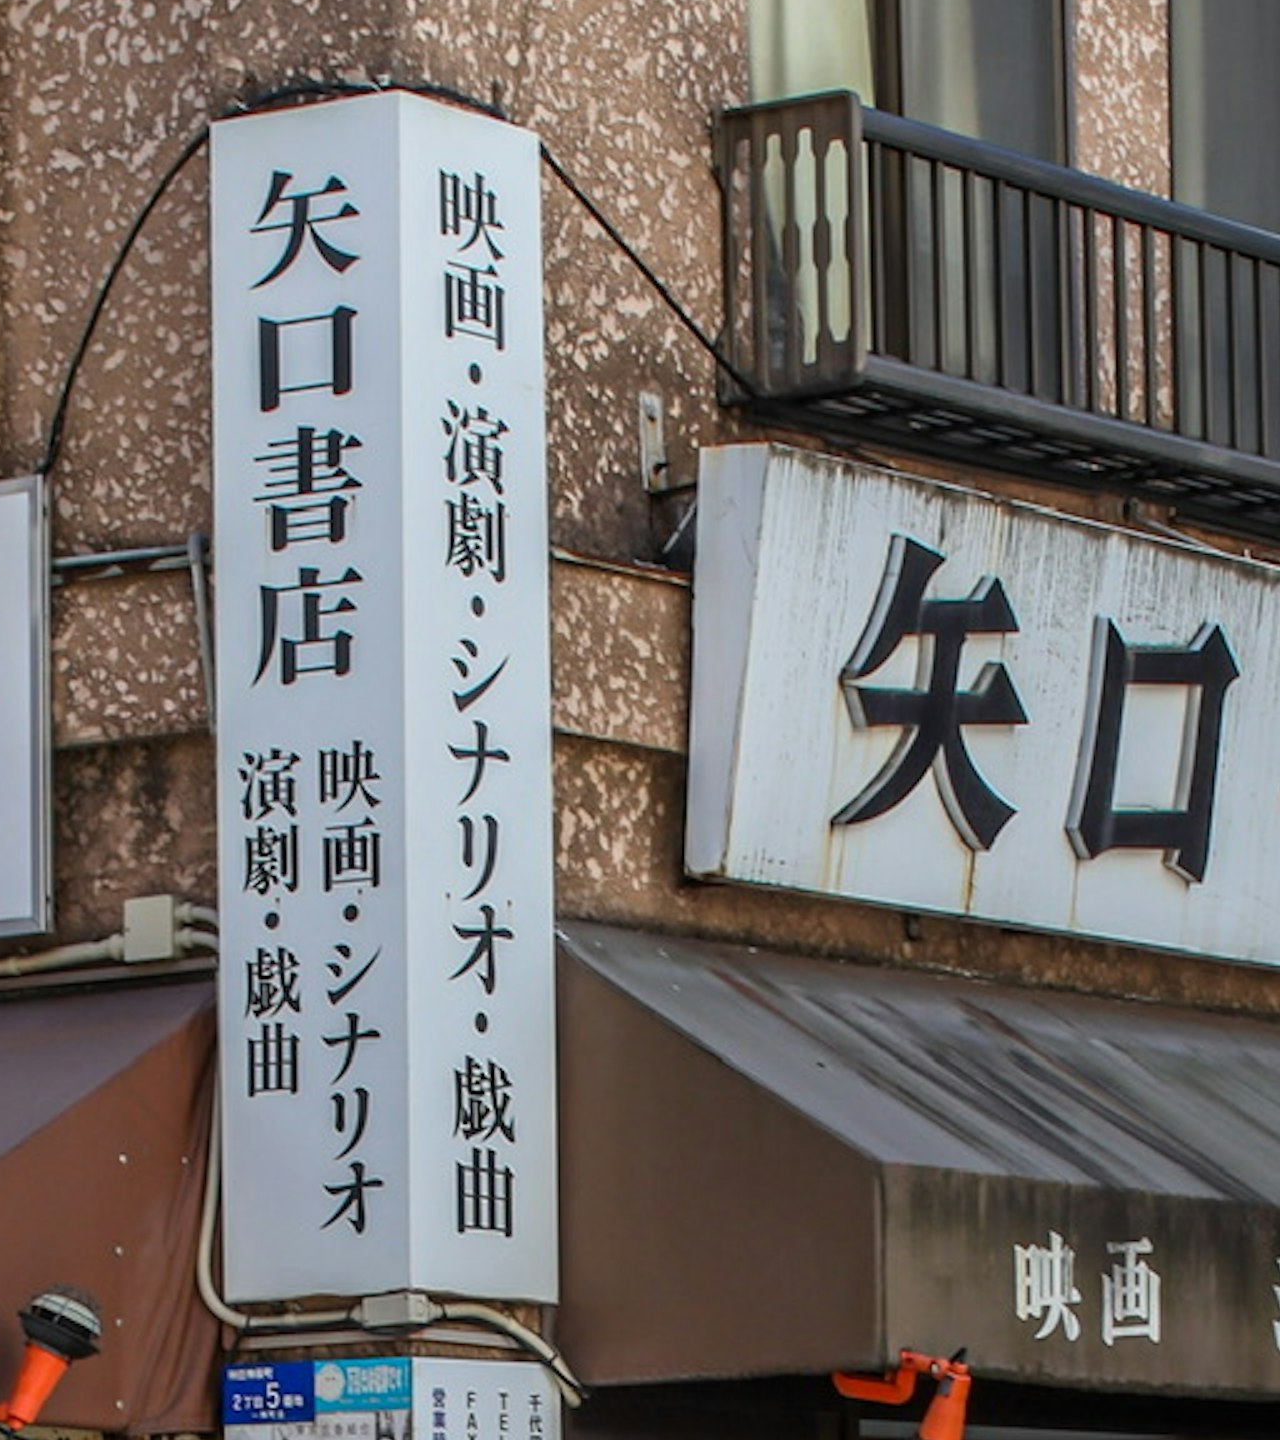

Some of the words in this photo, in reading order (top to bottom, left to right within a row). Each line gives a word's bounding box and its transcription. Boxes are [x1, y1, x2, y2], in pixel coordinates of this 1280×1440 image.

[249, 169, 364, 689] 矢口書店
[238, 748, 301, 1098] 演劇・戯曲
[439, 167, 516, 1238] 映画・演劇・シナリオ・戯曲
[318, 740, 384, 1235] 映画・シナリオ
[1013, 1229, 1161, 1347] 映画
